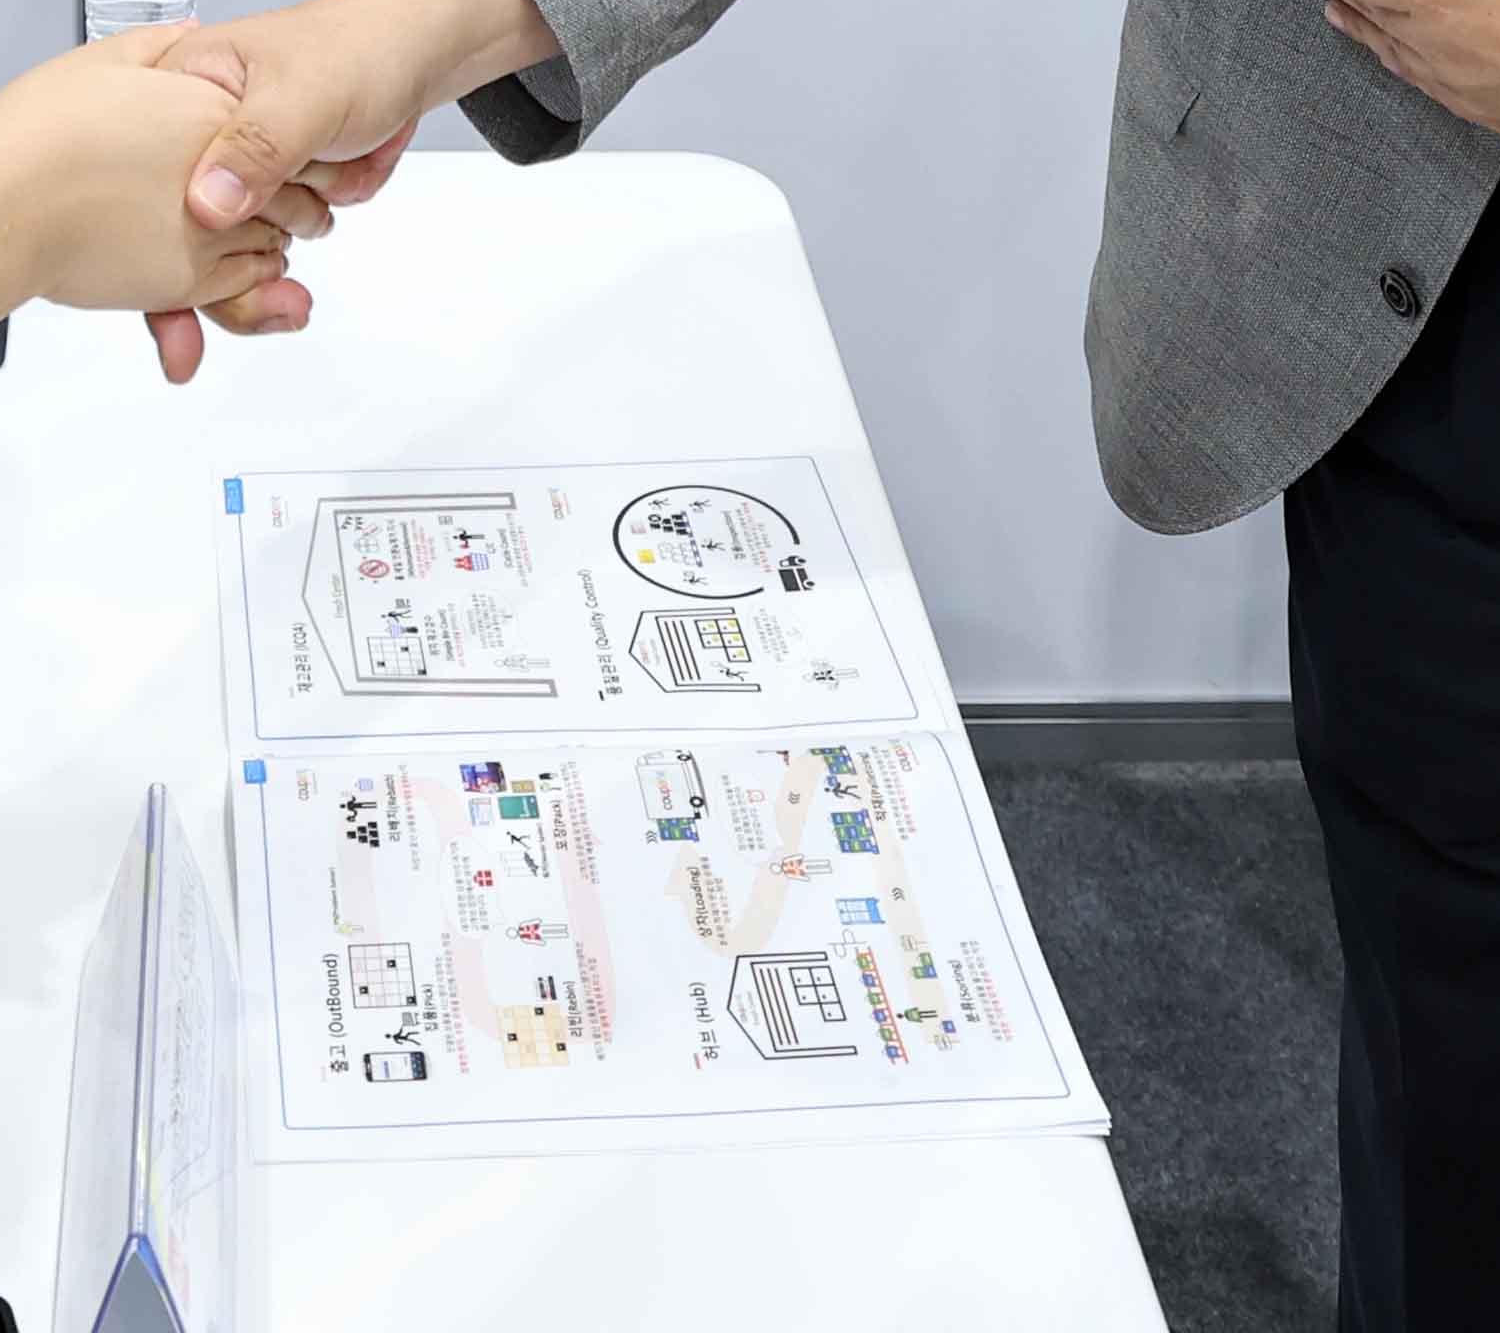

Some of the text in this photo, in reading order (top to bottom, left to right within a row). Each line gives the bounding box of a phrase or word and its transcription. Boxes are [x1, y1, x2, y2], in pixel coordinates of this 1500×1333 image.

[577, 569, 599, 609] Control)
[588, 611, 611, 651] (Quality
[322, 953, 350, 1074] 출고 (OutBound)
[688, 981, 722, 1062] 허브 (Hub)
